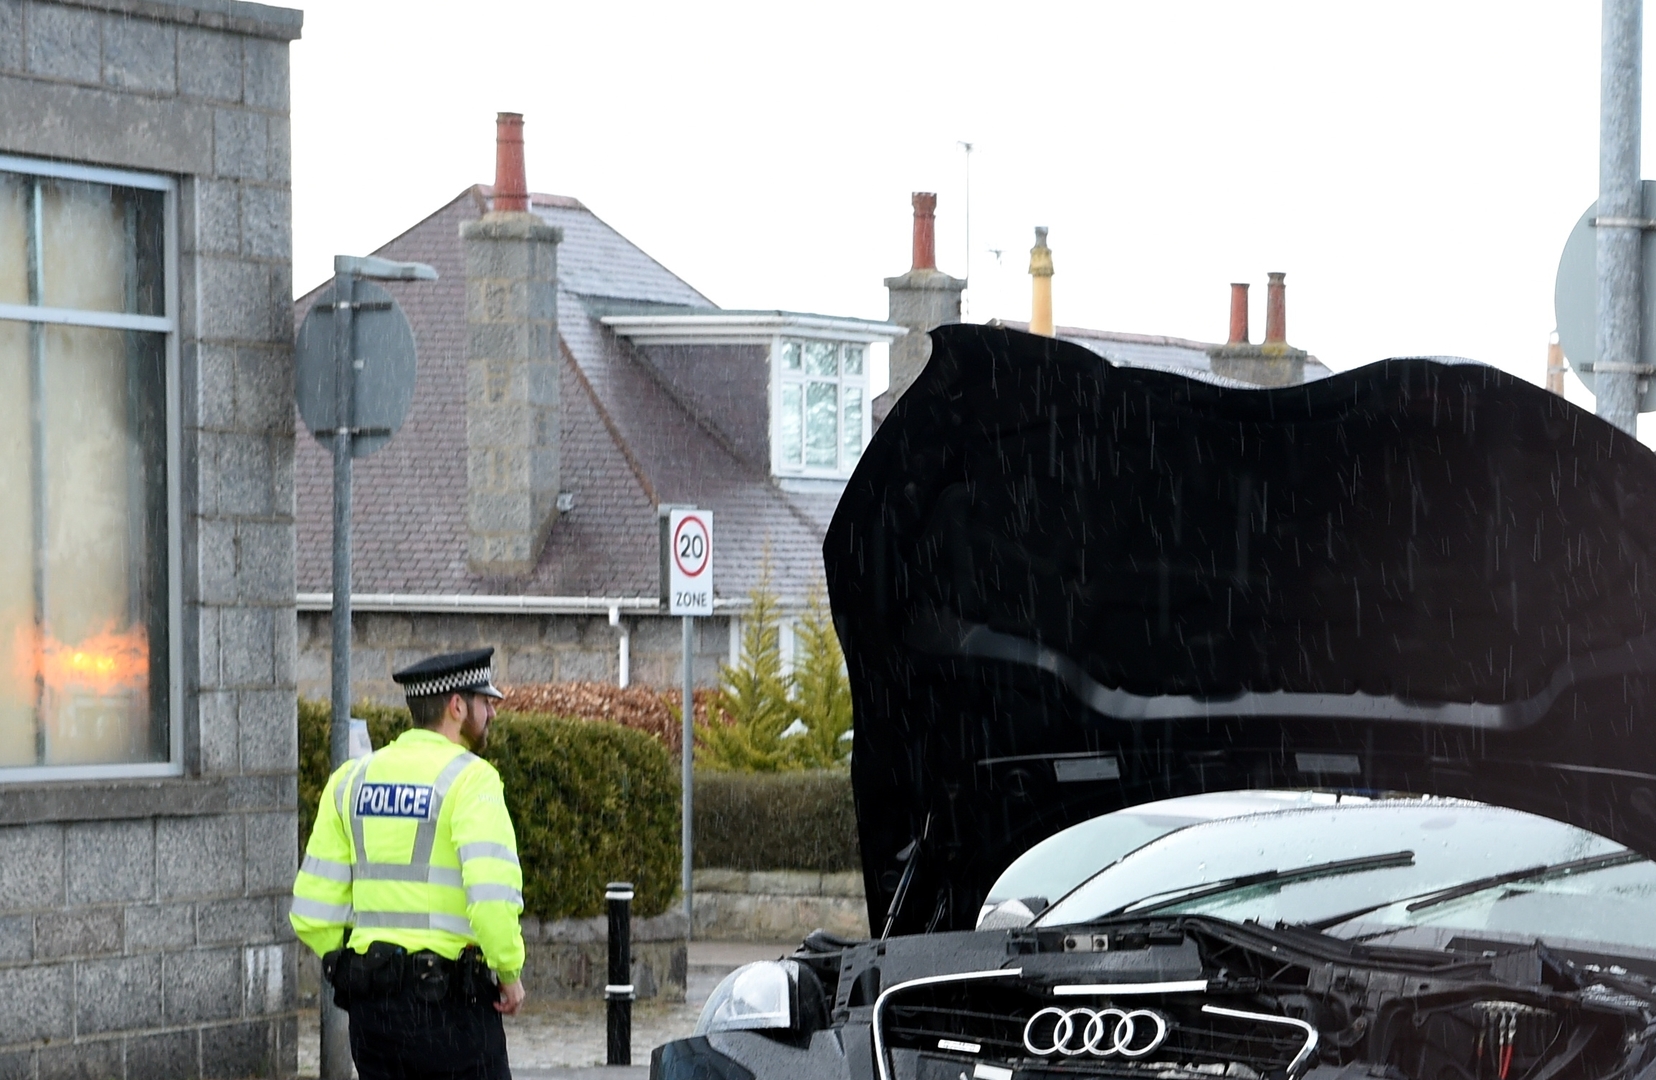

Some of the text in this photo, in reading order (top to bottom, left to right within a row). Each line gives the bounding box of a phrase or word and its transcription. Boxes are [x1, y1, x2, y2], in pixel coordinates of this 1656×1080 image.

[680, 534, 703, 559] 20
[676, 591, 708, 608] ZONE
[358, 785, 429, 815] POLICE
